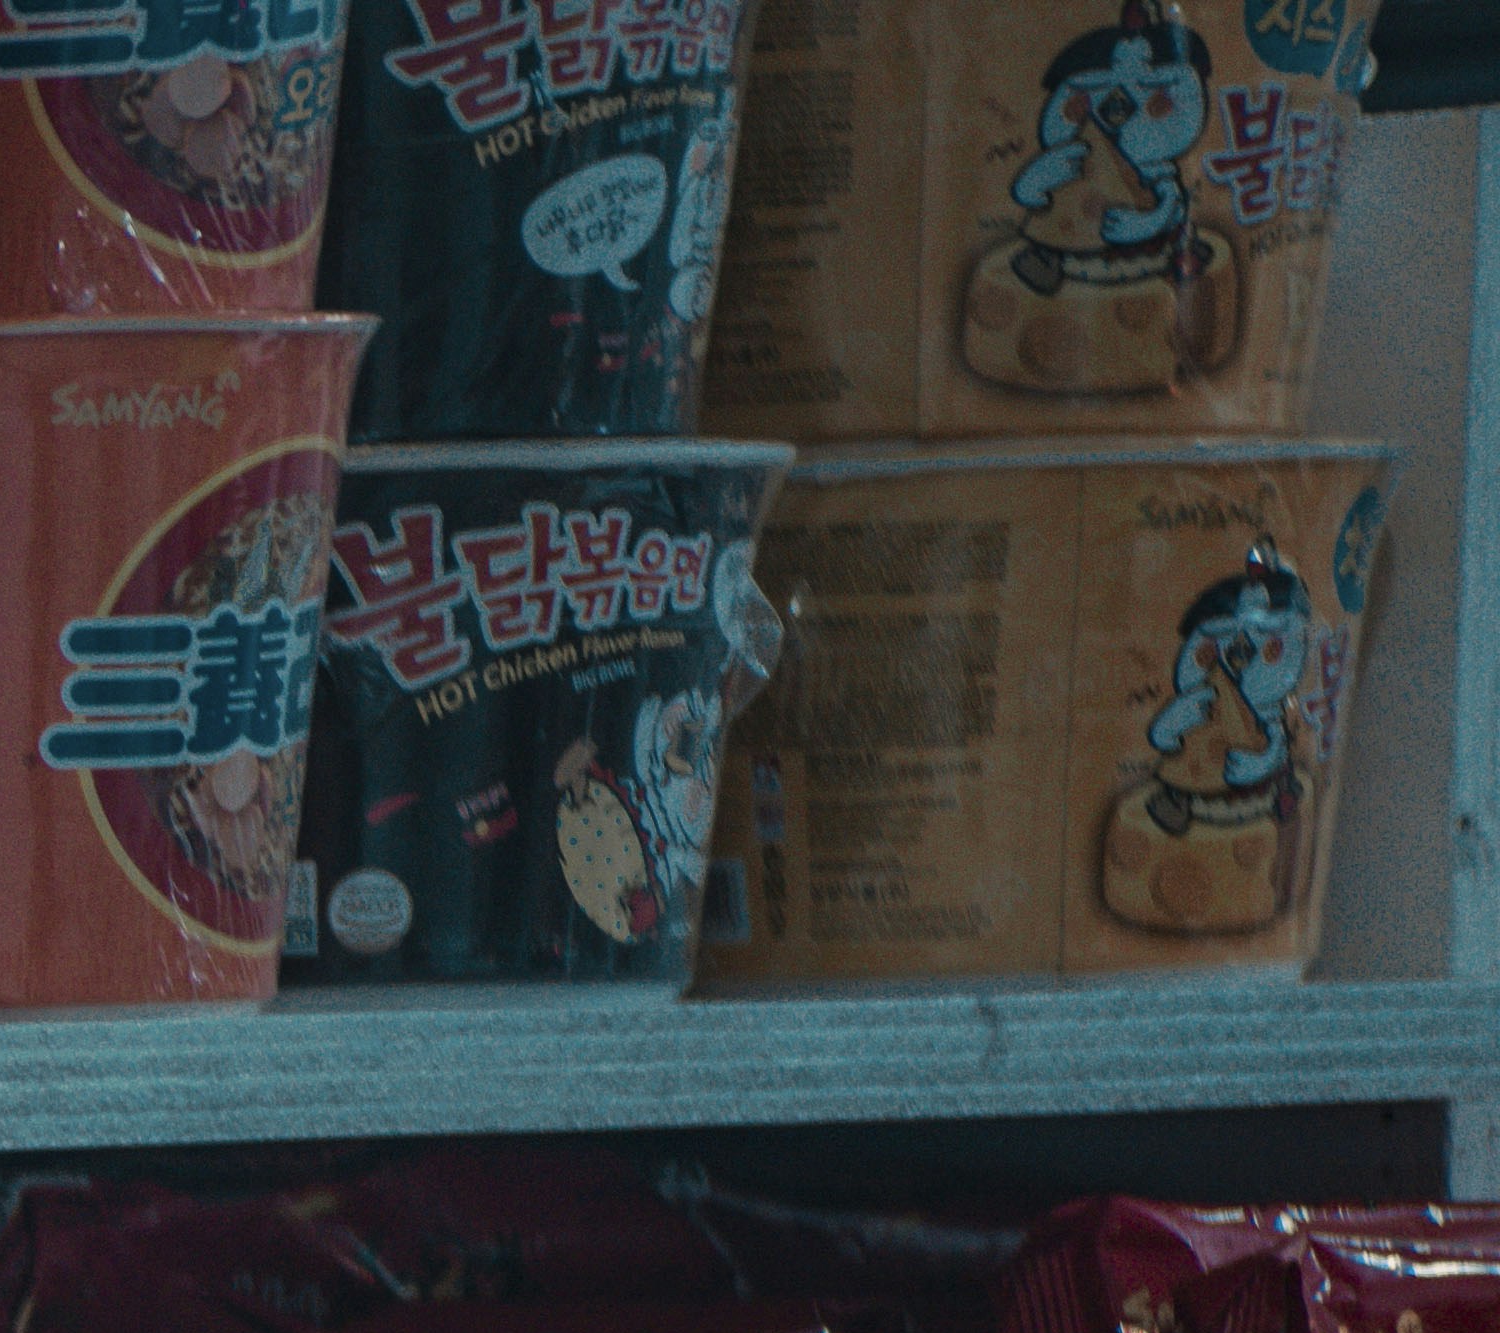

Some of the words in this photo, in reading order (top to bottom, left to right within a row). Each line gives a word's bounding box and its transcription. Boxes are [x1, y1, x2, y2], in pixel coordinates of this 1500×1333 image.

[474, 120, 534, 168] HOT
[1205, 81, 1340, 227] 불닭
[39, 600, 320, 770] 三養
[414, 674, 480, 727] HOT
[483, 639, 580, 694] Chicken
